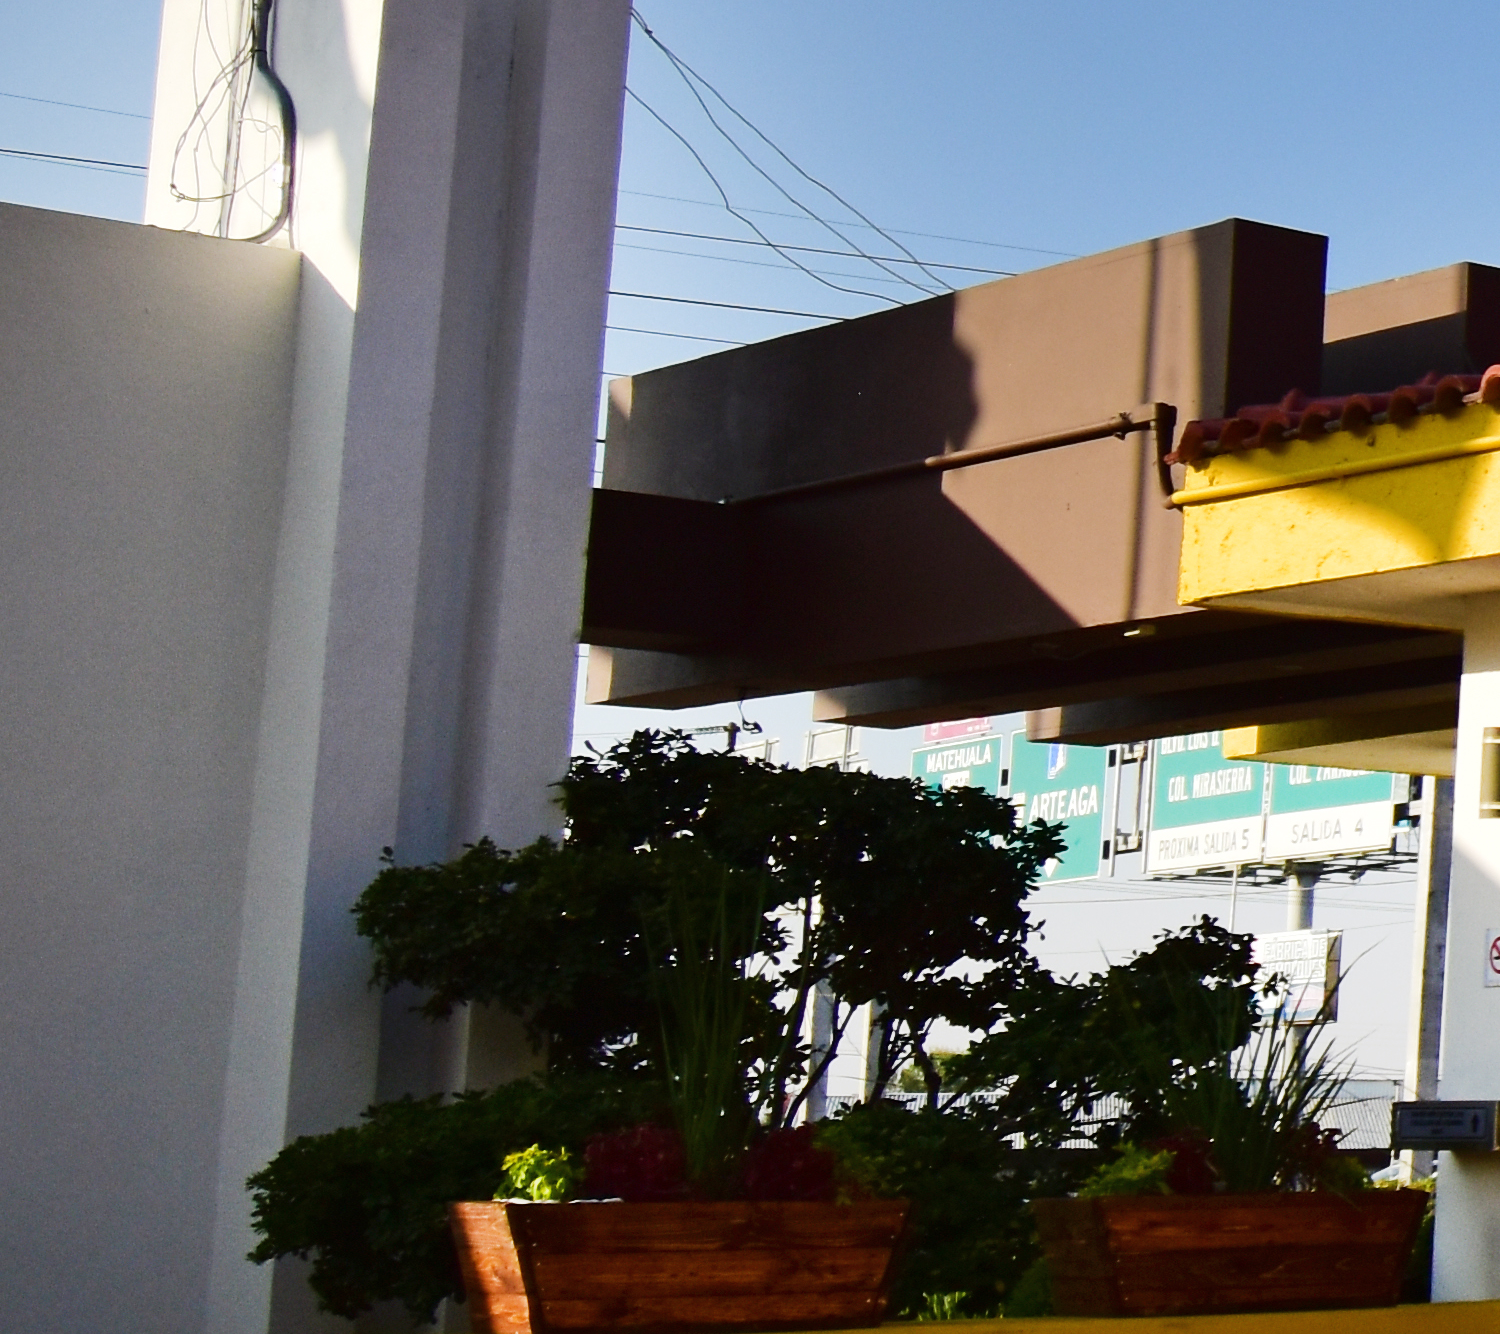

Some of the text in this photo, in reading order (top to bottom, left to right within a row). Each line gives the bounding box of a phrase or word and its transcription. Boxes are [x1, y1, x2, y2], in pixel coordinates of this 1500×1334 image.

[926, 743, 992, 774] MATEHUALA
[1191, 766, 1252, 800] MIRASIERRA
[1028, 784, 1099, 823] ARTEAGA
[1203, 831, 1237, 855] SALIDA
[1242, 829, 1250, 850] 5
[1291, 818, 1364, 845] SALIDA 4
